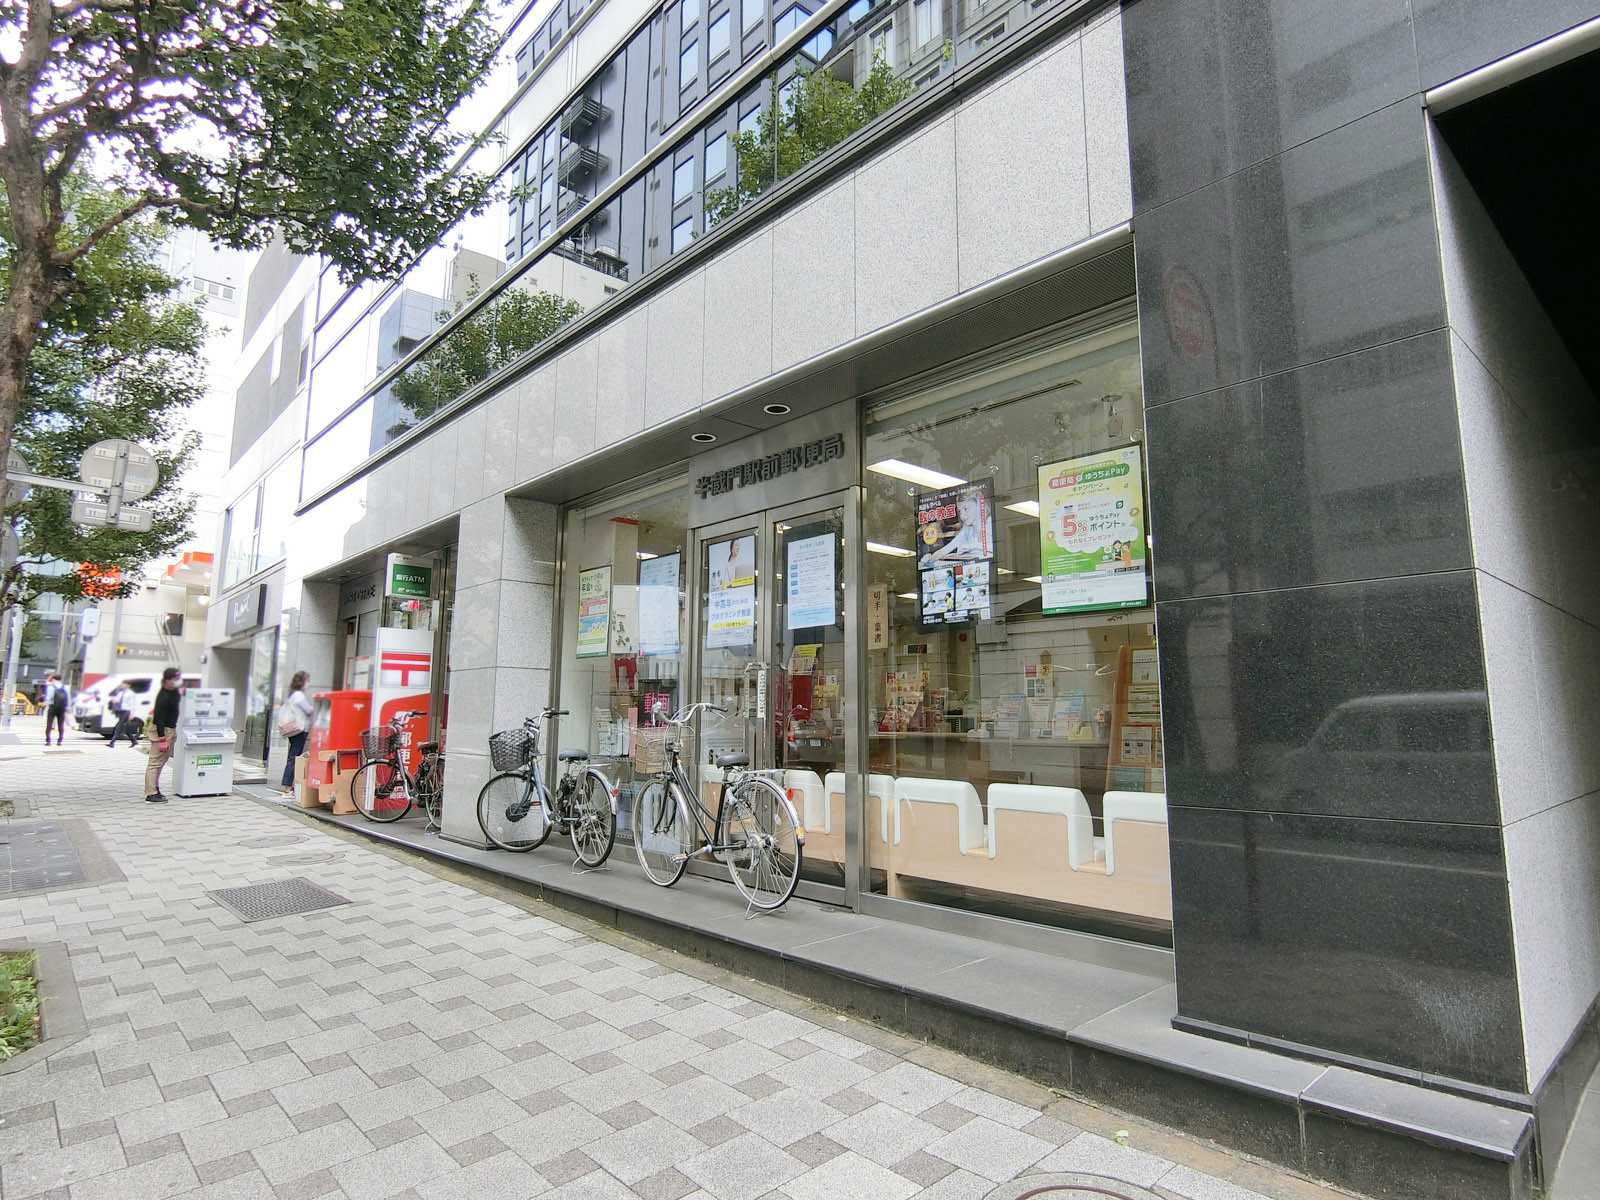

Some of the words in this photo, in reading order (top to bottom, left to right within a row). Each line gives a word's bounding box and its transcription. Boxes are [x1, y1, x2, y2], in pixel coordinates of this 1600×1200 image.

[695, 433, 844, 499] 半蔵門駅前郵便局
[1072, 482, 1104, 492] キャンペーン
[1089, 513, 1120, 521] ゆうちょPay
[1063, 514, 1087, 537] 5%
[396, 573, 425, 583] 銀行ATM
[711, 608, 751, 620] プログラミング教室
[873, 591, 882, 643] 切手・葉書
[129, 649, 166, 657] T-POINT
